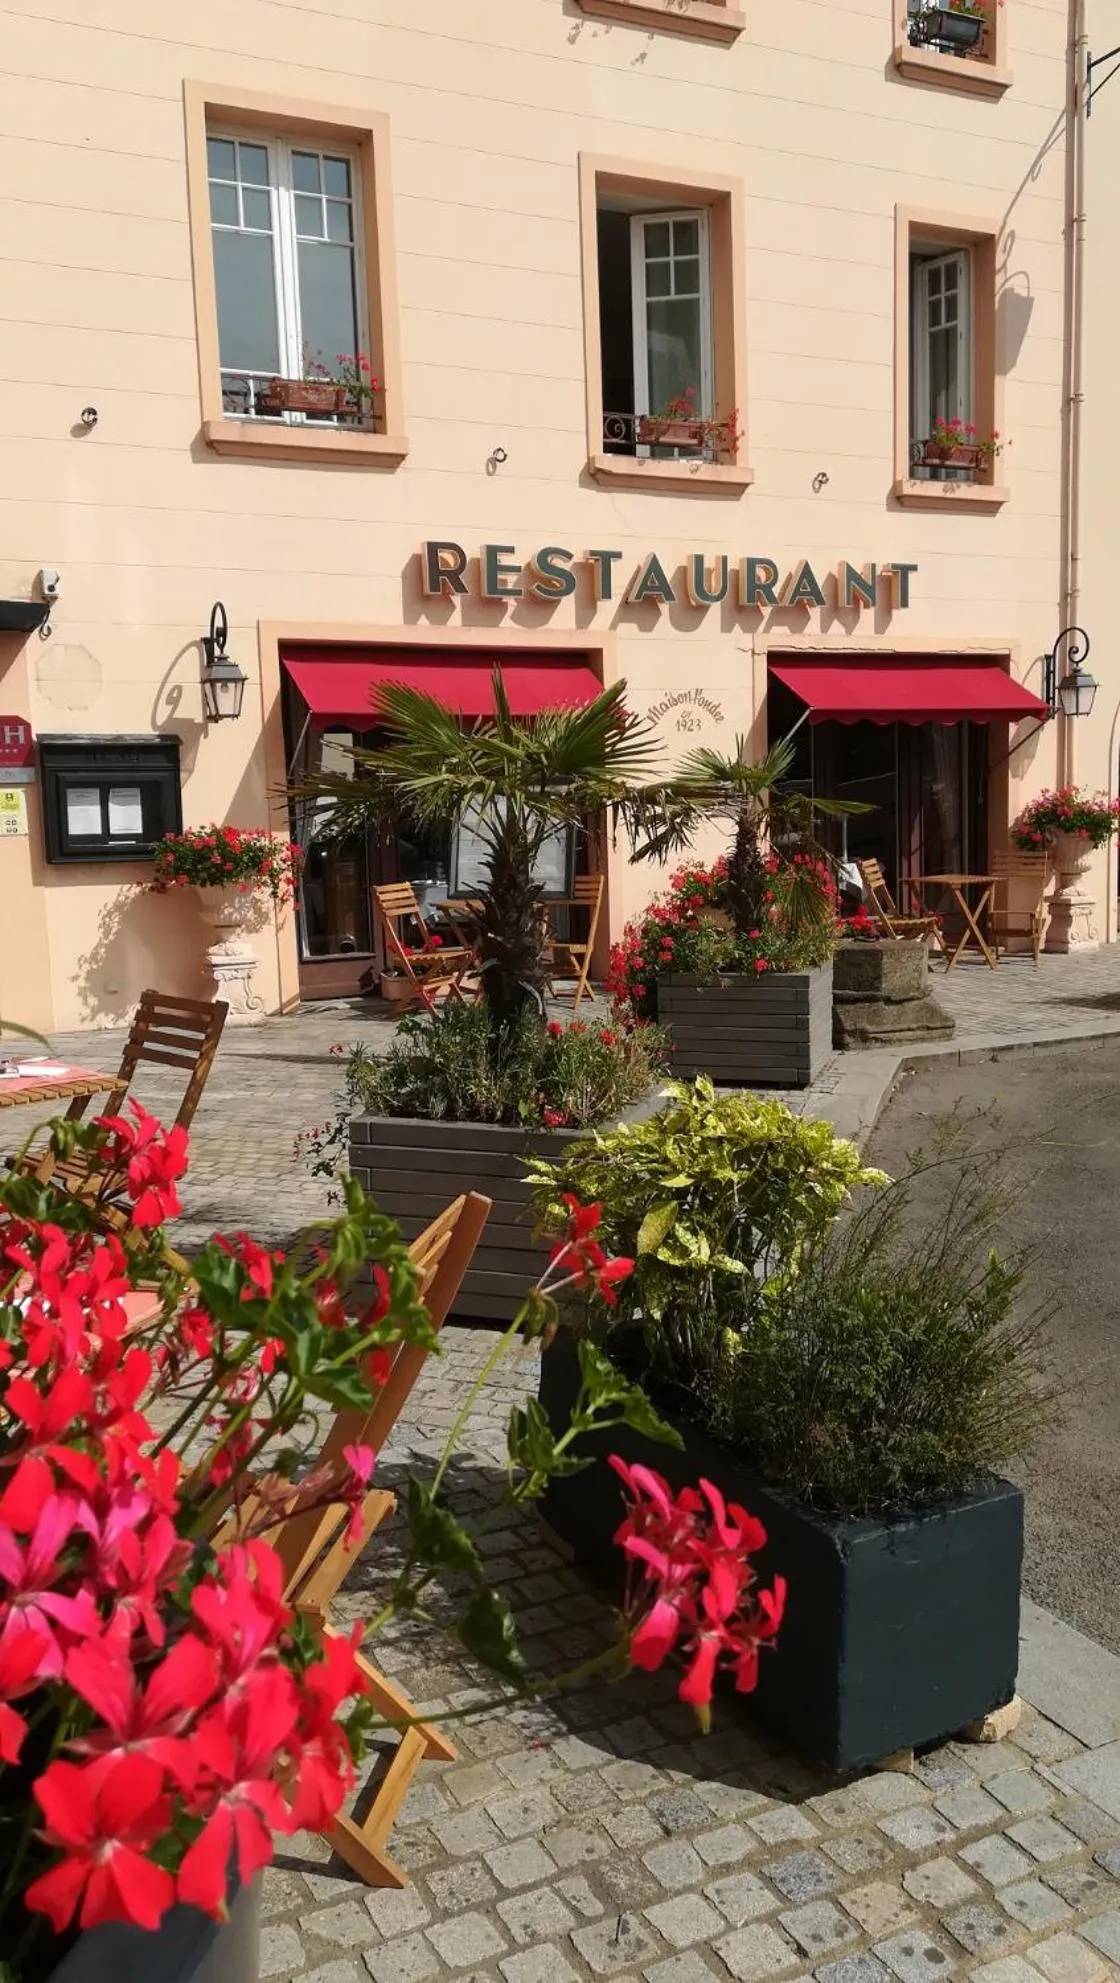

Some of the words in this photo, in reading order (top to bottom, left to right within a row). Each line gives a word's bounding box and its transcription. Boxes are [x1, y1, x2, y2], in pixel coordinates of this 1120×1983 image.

[422, 540, 918, 609] RESTAURANT
[4, 725, 24, 744] H
[676, 719, 701, 732] 1923
